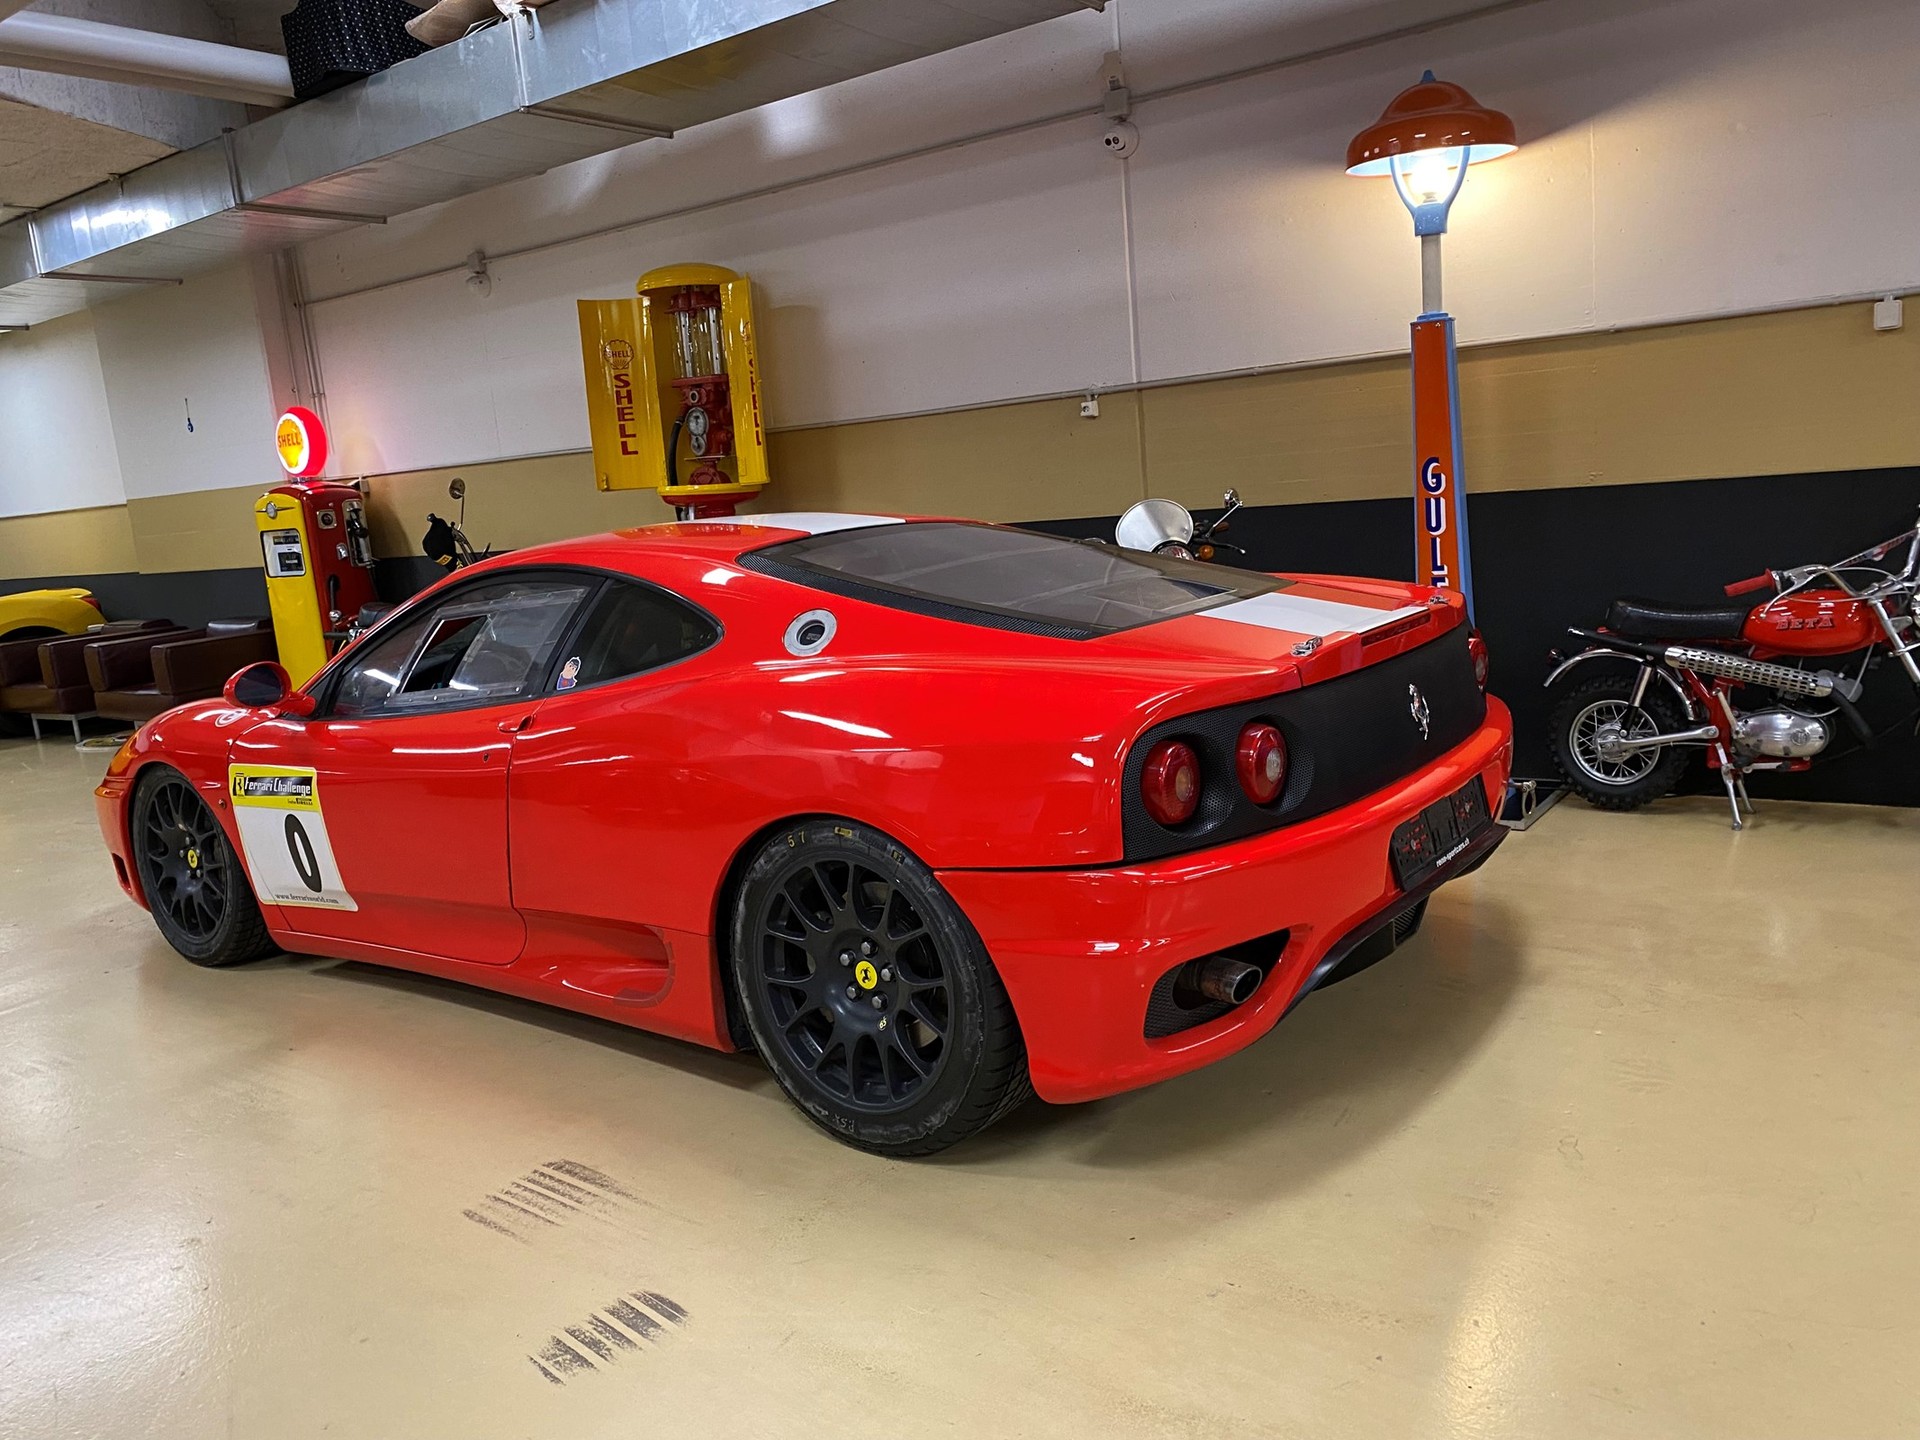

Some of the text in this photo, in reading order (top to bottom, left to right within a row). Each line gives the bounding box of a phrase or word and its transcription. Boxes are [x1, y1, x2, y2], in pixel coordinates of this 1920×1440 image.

[613, 373, 639, 456] SHELL
[277, 432, 302, 449] SHELL
[1776, 616, 1834, 630] BETA
[244, 776, 311, 797] Ferrari Challenge
[284, 813, 323, 893] 0
